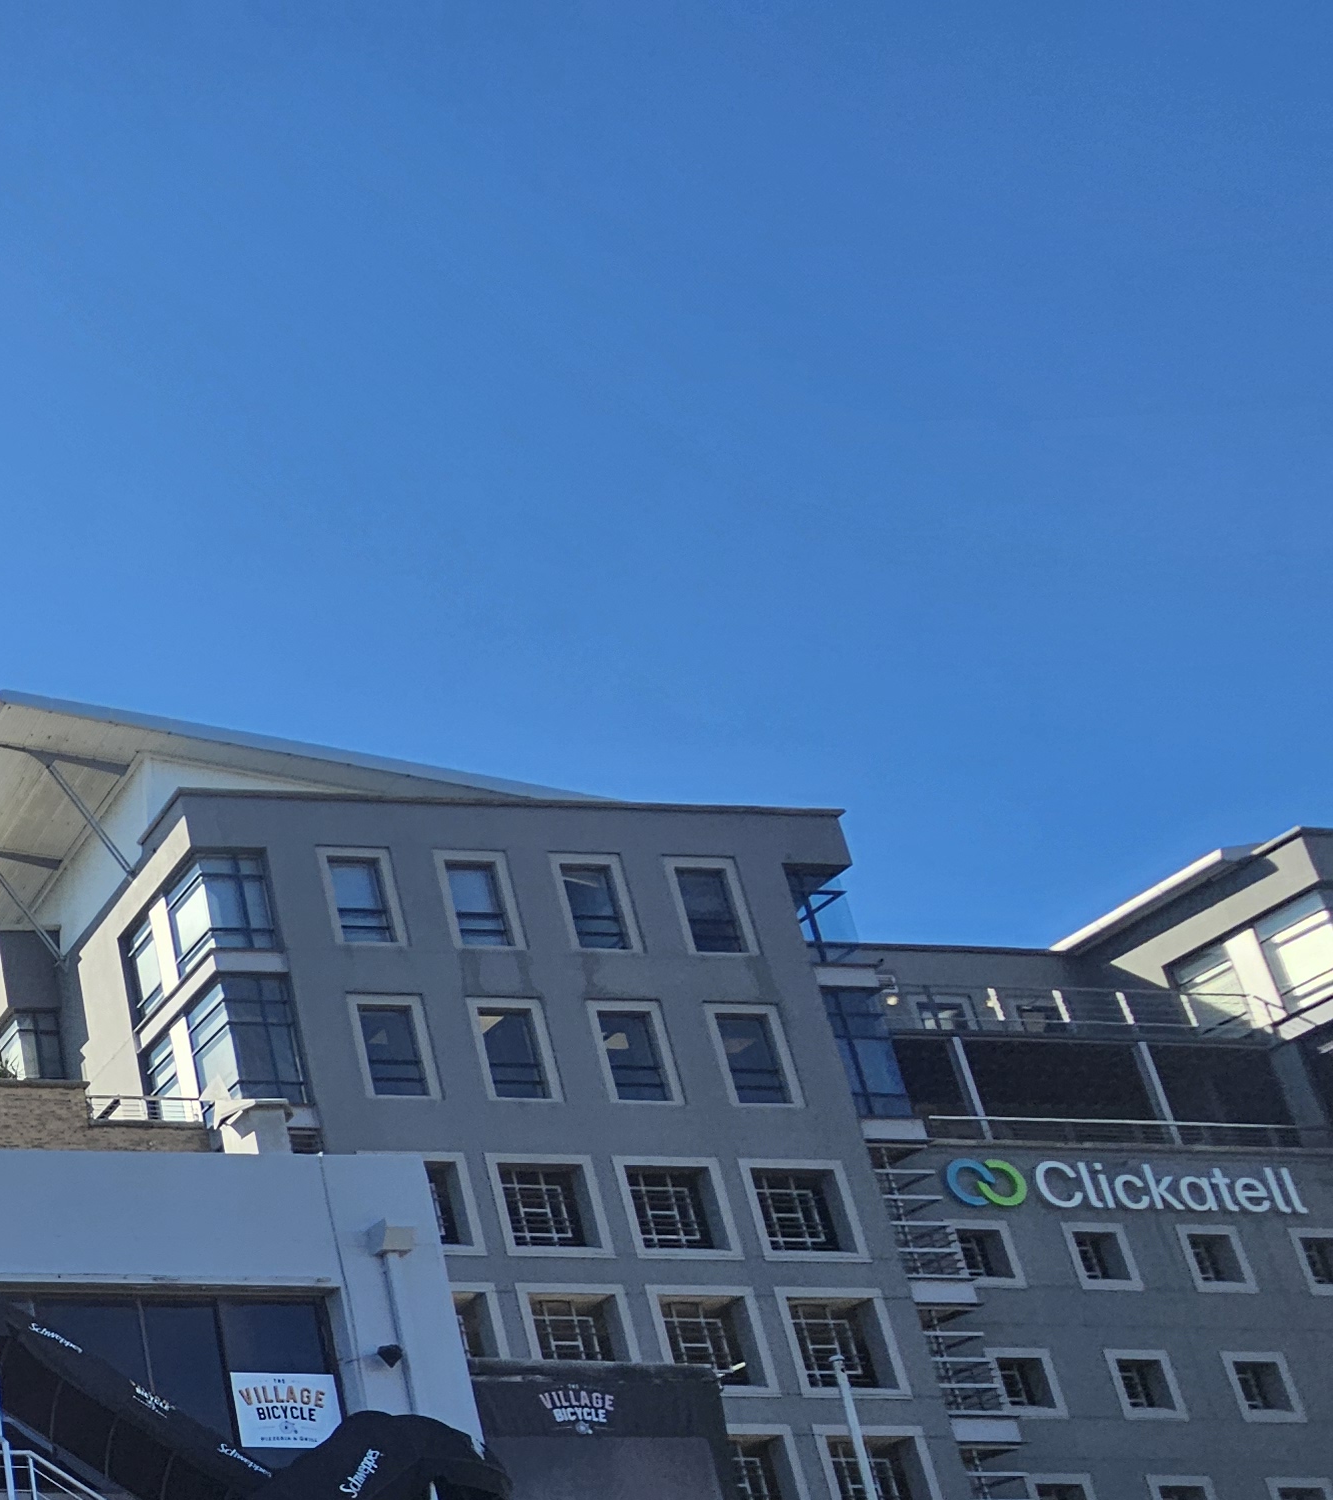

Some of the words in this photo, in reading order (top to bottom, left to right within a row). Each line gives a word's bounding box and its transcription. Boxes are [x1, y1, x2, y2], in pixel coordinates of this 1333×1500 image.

[1035, 1160, 1309, 1214] Clickatell
[239, 1385, 326, 1408] VILLAGE
[539, 1390, 614, 1411] VILLAGE
[256, 1406, 317, 1422] BICYCLE
[553, 1408, 607, 1423] BICYCLE
[339, 1449, 380, 1498] Schweppes
